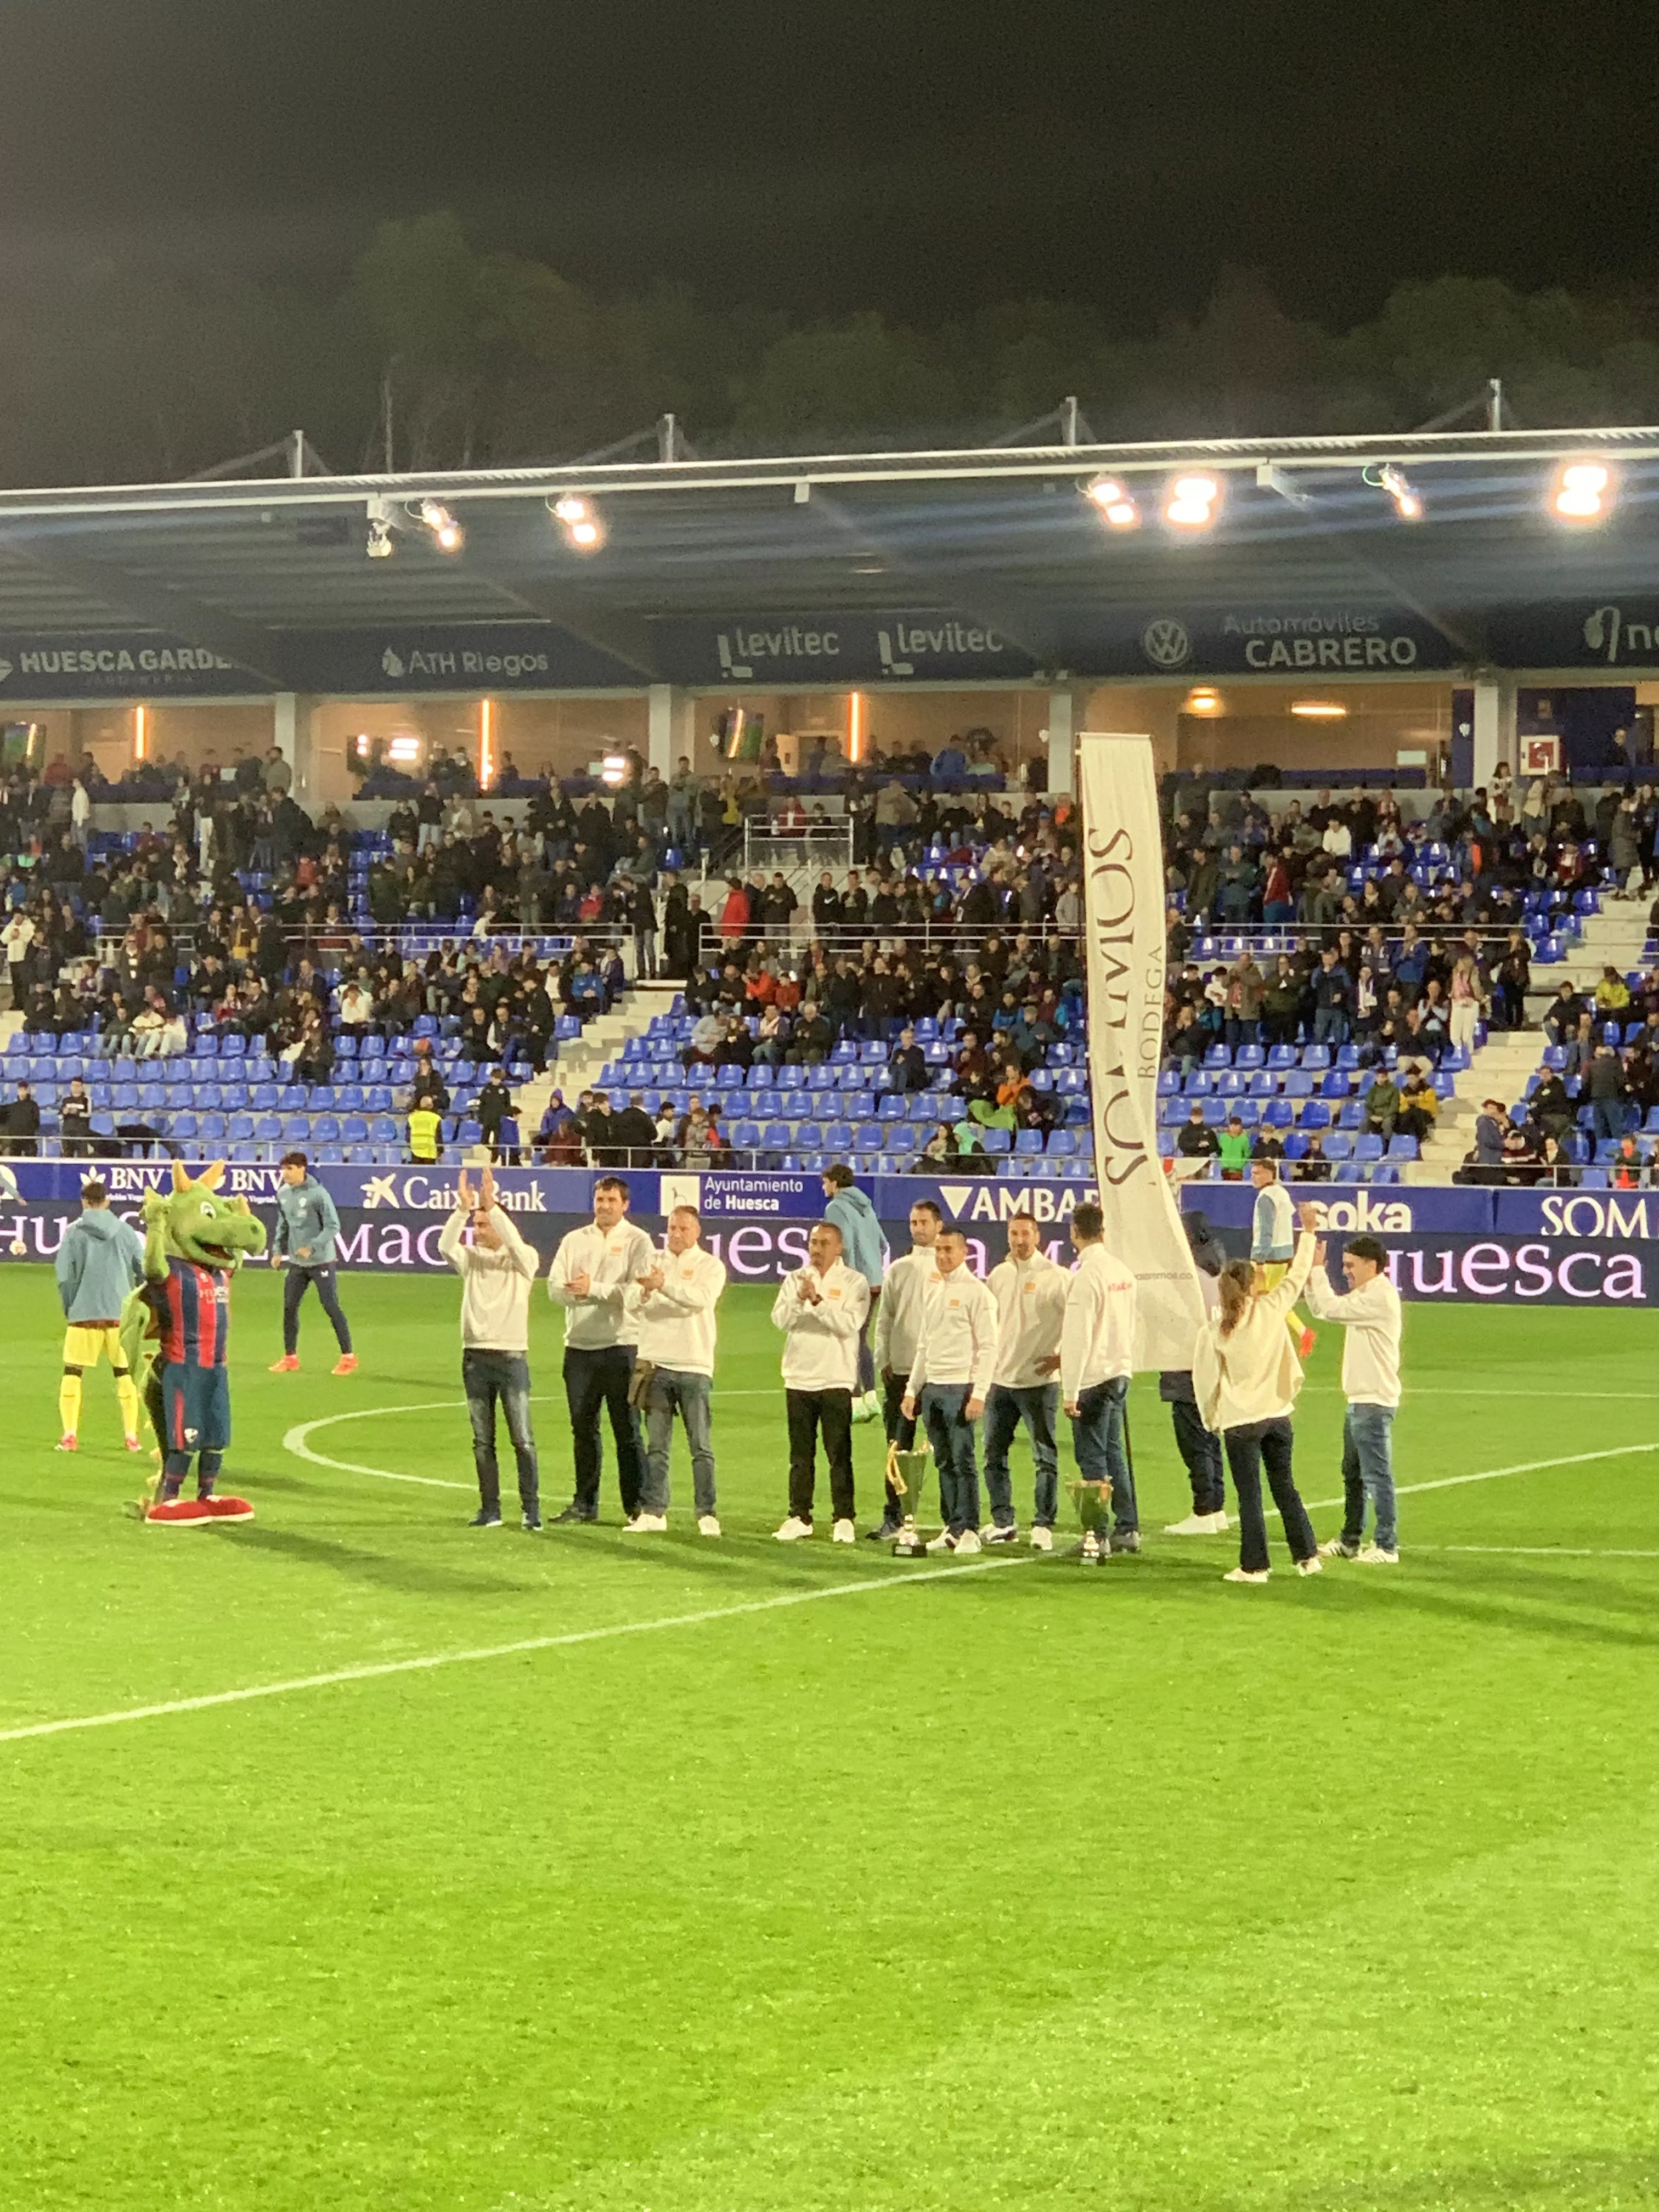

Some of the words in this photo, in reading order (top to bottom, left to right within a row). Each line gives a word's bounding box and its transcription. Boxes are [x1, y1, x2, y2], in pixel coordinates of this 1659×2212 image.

[20, 649, 136, 673] HUESCA
[409, 650, 455, 674] ATH
[462, 651, 549, 677] Riegos
[1245, 636, 1416, 667] CABRERO
[1137, 945, 1163, 1079] BODEGA
[110, 1167, 165, 1190] BNV
[705, 1176, 804, 1195] Ayuntamiento
[704, 1195, 721, 1210] de
[725, 1194, 780, 1211] Huesca
[1541, 1196, 1659, 1239] SOM
